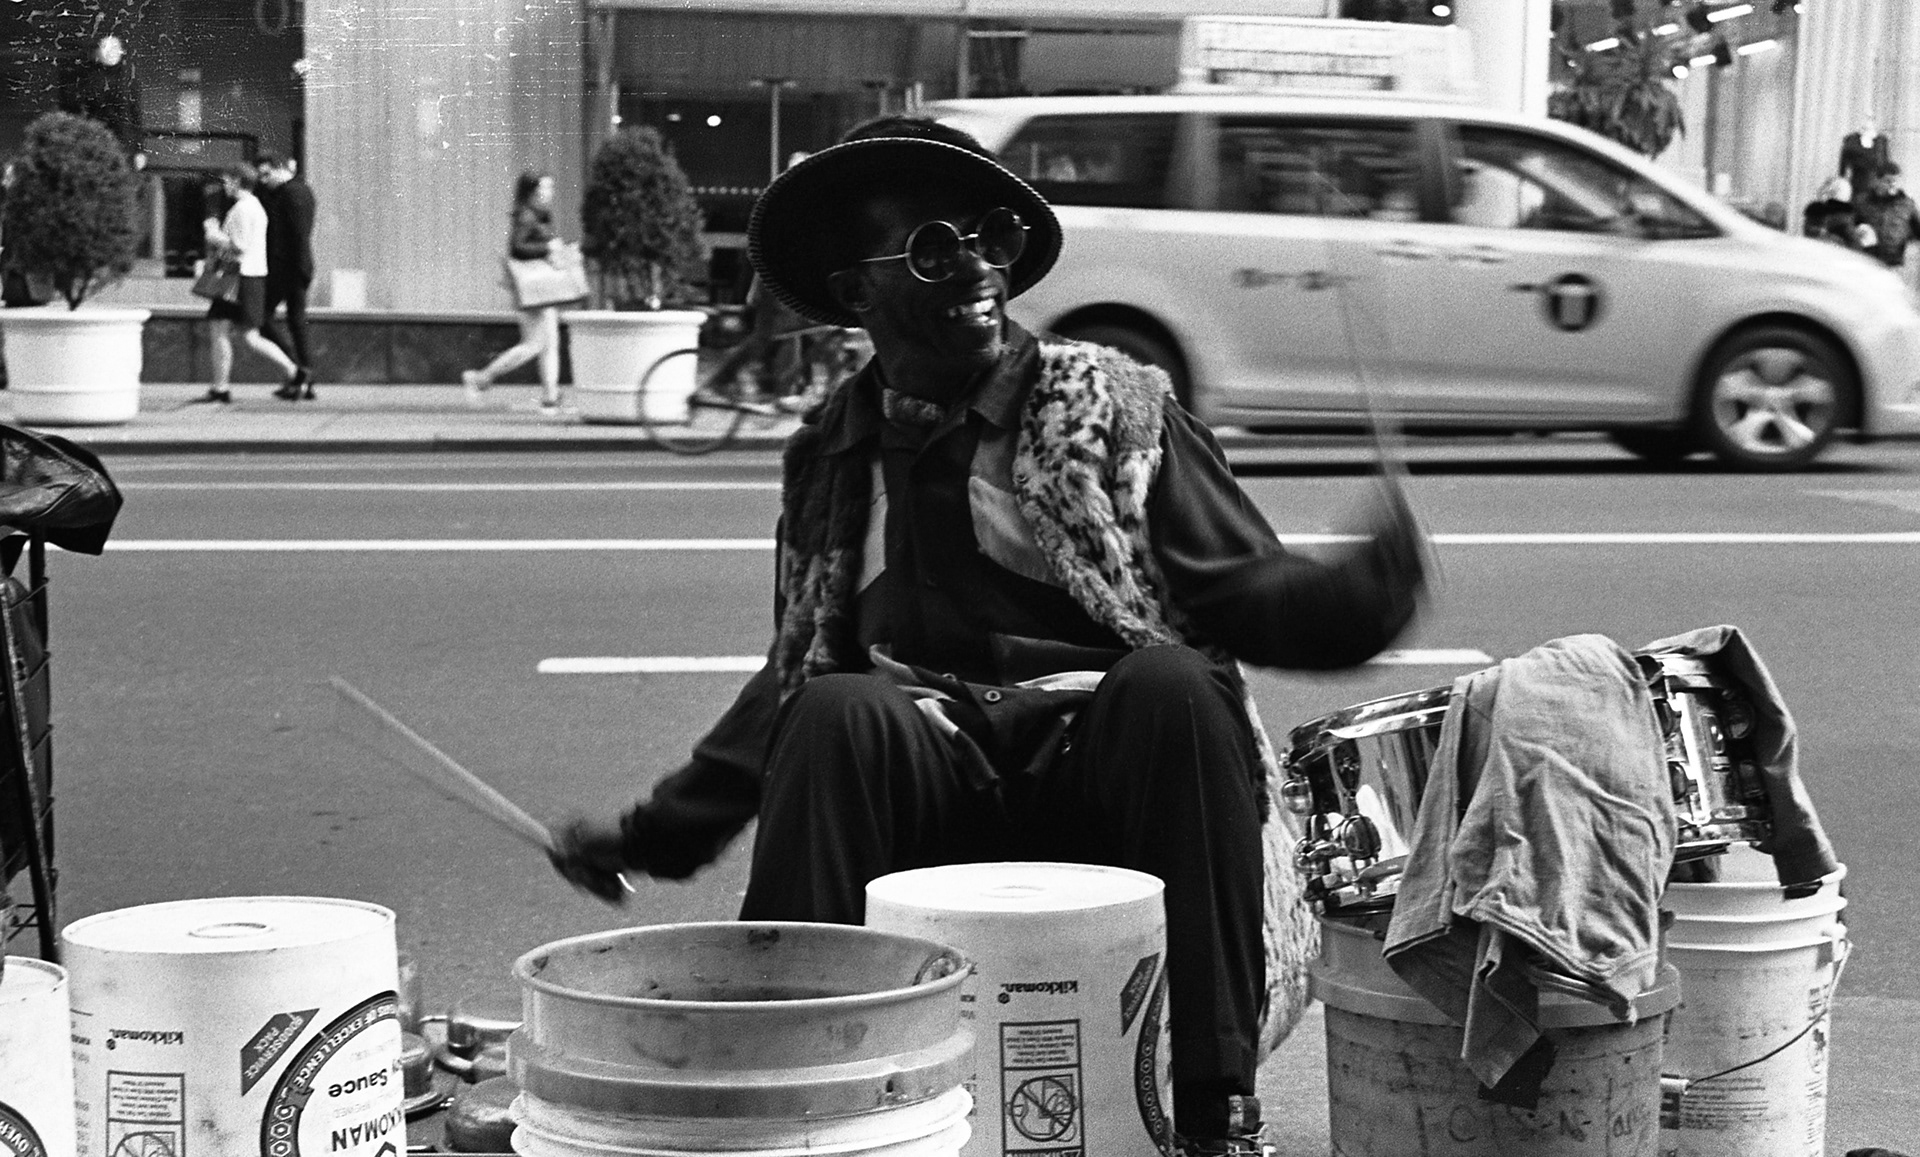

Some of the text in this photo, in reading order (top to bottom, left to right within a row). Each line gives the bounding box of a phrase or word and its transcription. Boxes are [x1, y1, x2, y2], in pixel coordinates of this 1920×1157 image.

[243, 1015, 303, 1079] FOODSERVICE
[253, 1025, 279, 1052] PACK
[293, 1017, 363, 1089] EXCELLENCE
[328, 1069, 388, 1098] Sauce
